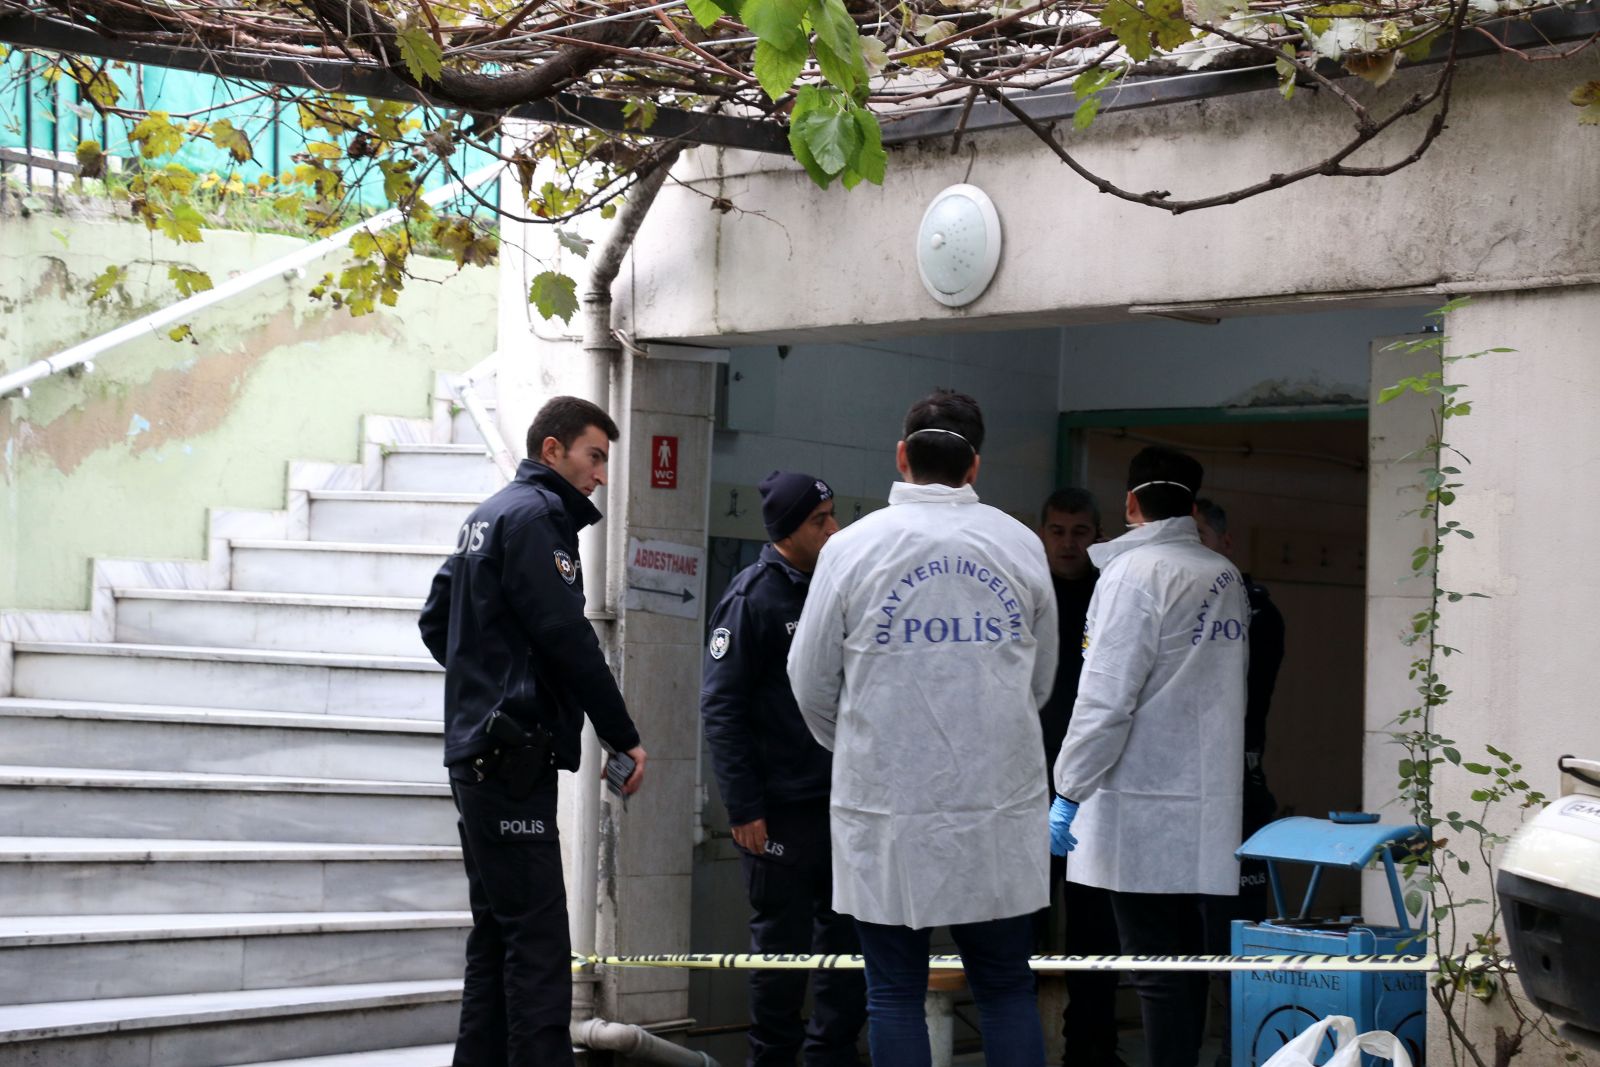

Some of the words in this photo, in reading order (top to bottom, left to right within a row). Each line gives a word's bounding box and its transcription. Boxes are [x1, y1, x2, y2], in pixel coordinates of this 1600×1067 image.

[654, 469, 674, 480] WC
[633, 548, 698, 577] ABDESTHANE
[875, 590, 902, 645] OLAY
[900, 555, 949, 588] YERİ
[902, 611, 1004, 643] POLİS
